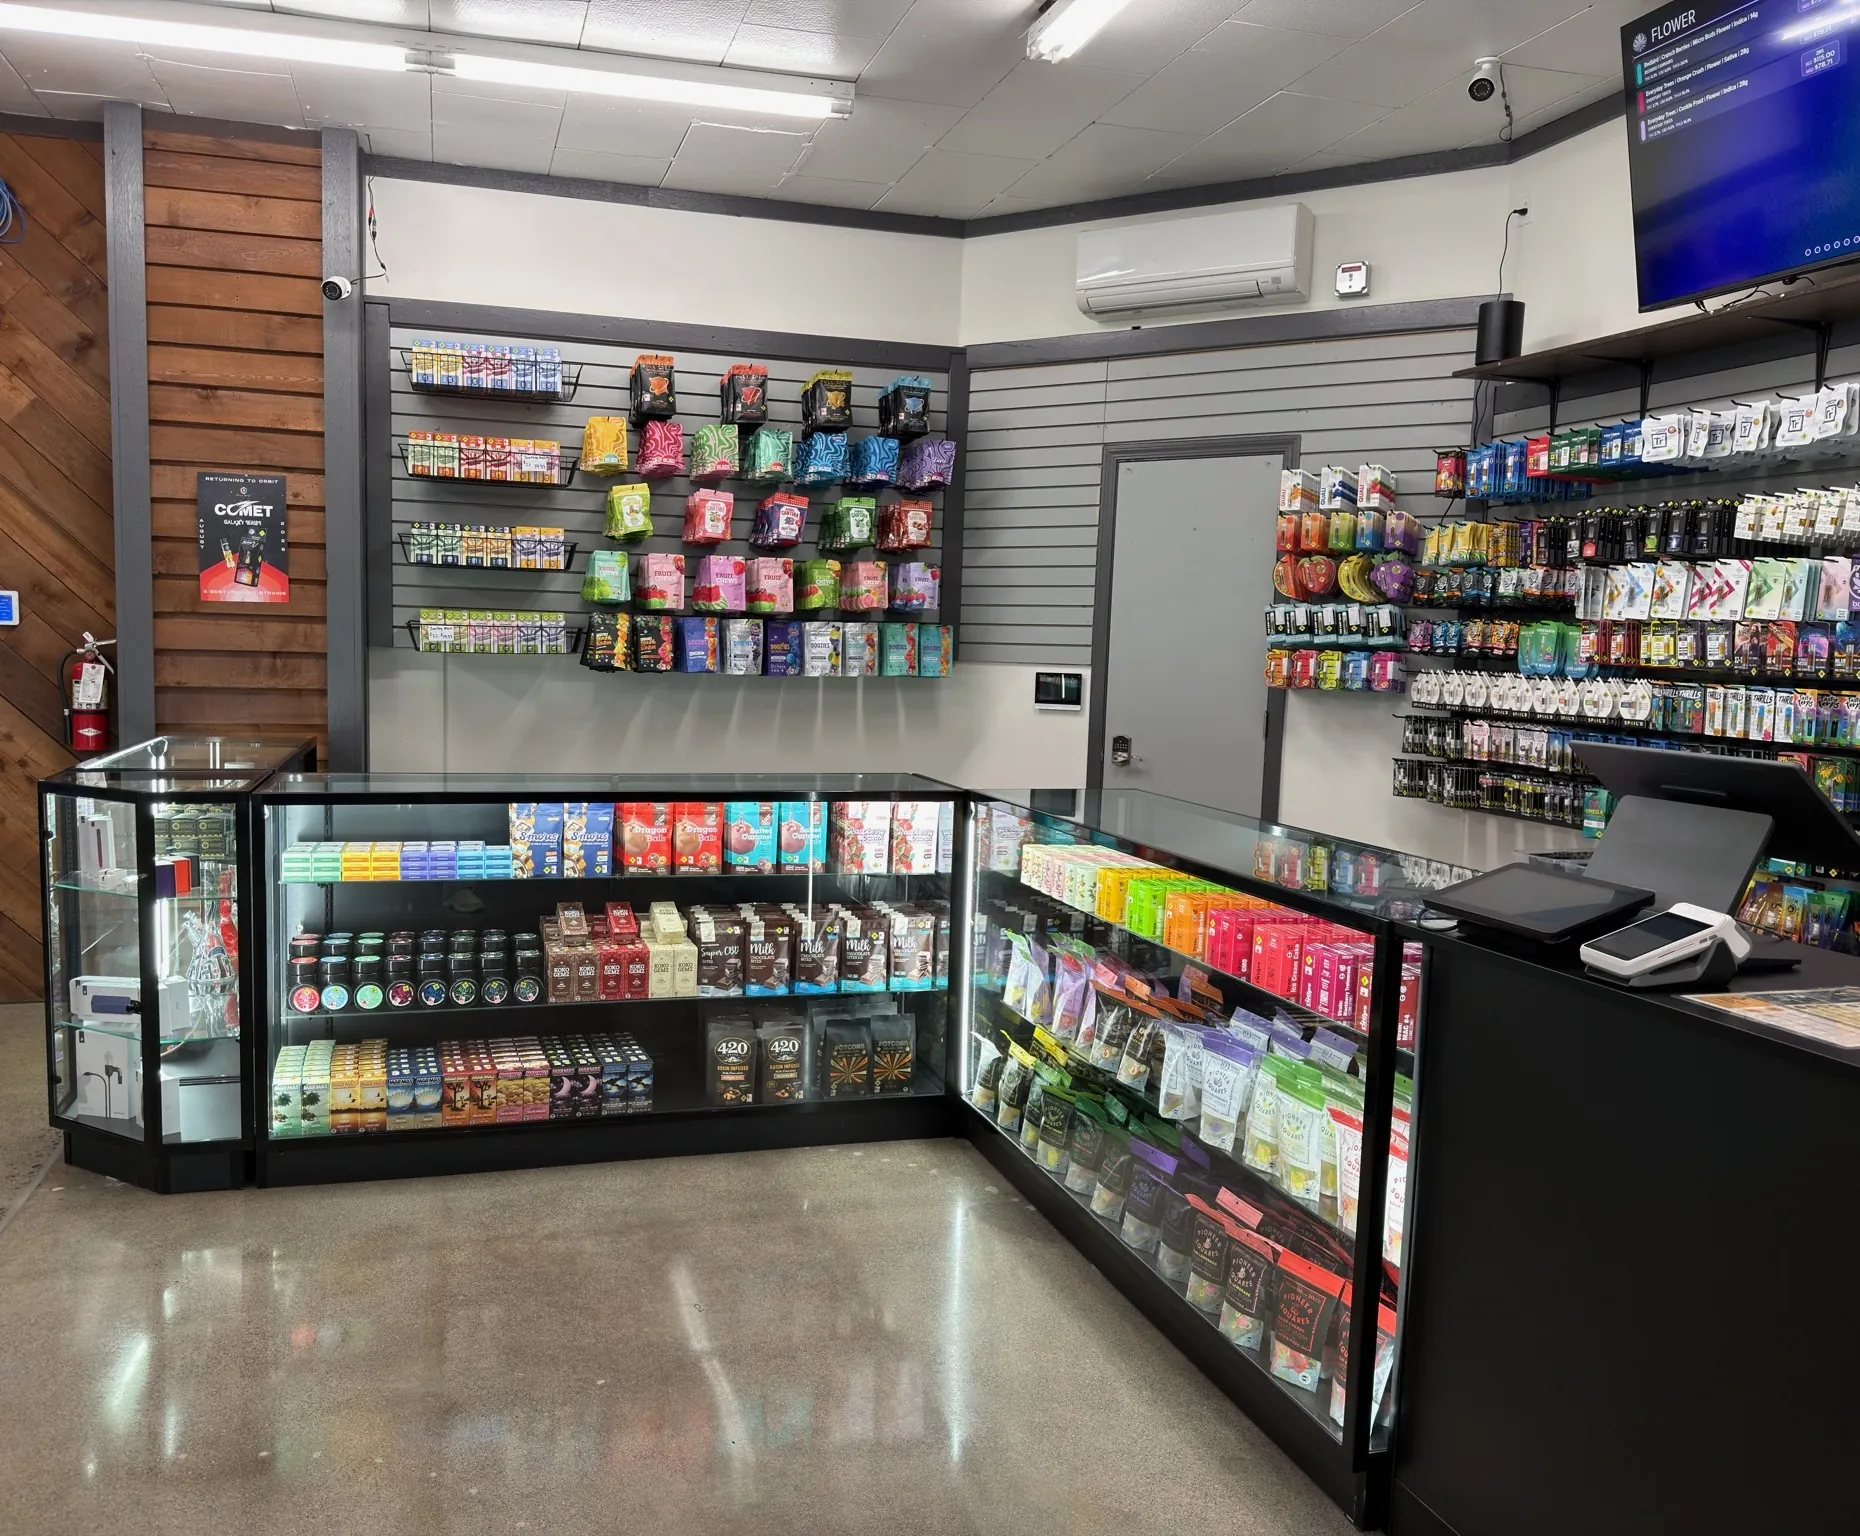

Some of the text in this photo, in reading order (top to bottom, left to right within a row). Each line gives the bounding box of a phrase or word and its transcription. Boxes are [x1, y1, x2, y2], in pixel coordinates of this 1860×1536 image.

[1651, 10, 1696, 43] FLOWER
[1662, 50, 1675, 60] Crunch
[1676, 44, 1690, 53] Berries
[1693, 36, 1704, 45] Micro
[1705, 31, 1715, 39] Buds
[1716, 24, 1731, 34] Flower
[1734, 17, 1747, 27] Indica
[1750, 12, 1758, 20] 14g
[1814, 50, 1835, 63] $115.00
[1815, 58, 1832, 70] $78.71
[1646, 85, 1663, 96] Everyday
[1677, 74, 1691, 83] Orange
[1692, 67, 1704, 76] Crush
[1707, 60, 1721, 70] Flower
[1724, 53, 1737, 62] Sativa
[1740, 48, 1749, 56] 28g
[1648, 114, 1665, 125] Everyday
[1679, 103, 1692, 112] Cookie
[1693, 97, 1703, 106] Frost
[1706, 89, 1721, 101] Flower
[1724, 85, 1736, 94] Indica
[214, 500, 273, 517] COMET
[1678, 690, 1702, 698] THRILLS
[1708, 691, 1722, 700] THRILLS
[1729, 692, 1744, 700] THRILLS
[1754, 694, 1773, 704] THRILLS
[647, 834, 666, 842] Balls
[698, 834, 717, 842] Balls
[750, 943, 775, 955] Milk
[801, 941, 825, 953] Milk
[846, 939, 871, 951] Milk
[893, 937, 918, 949] Milk
[701, 945, 739, 957] Super CBD
[1404, 1014, 1410, 1024] #4
[718, 1042, 748, 1054] 420
[770, 1040, 799, 1052] 420
[1209, 1070, 1230, 1085] PIONEER
[1206, 1079, 1227, 1094] SQUARES
[1281, 1112, 1307, 1130] PIONEER
[1280, 1124, 1304, 1141] SQUARES
[1197, 1229, 1222, 1247] PIONEER
[1195, 1239, 1219, 1257] SQUARES
[1232, 1258, 1256, 1278] PIONEER
[1230, 1268, 1253, 1287] SQUARES
[1284, 1293, 1313, 1314] PIONEER
[1280, 1303, 1310, 1325] SQUARES
